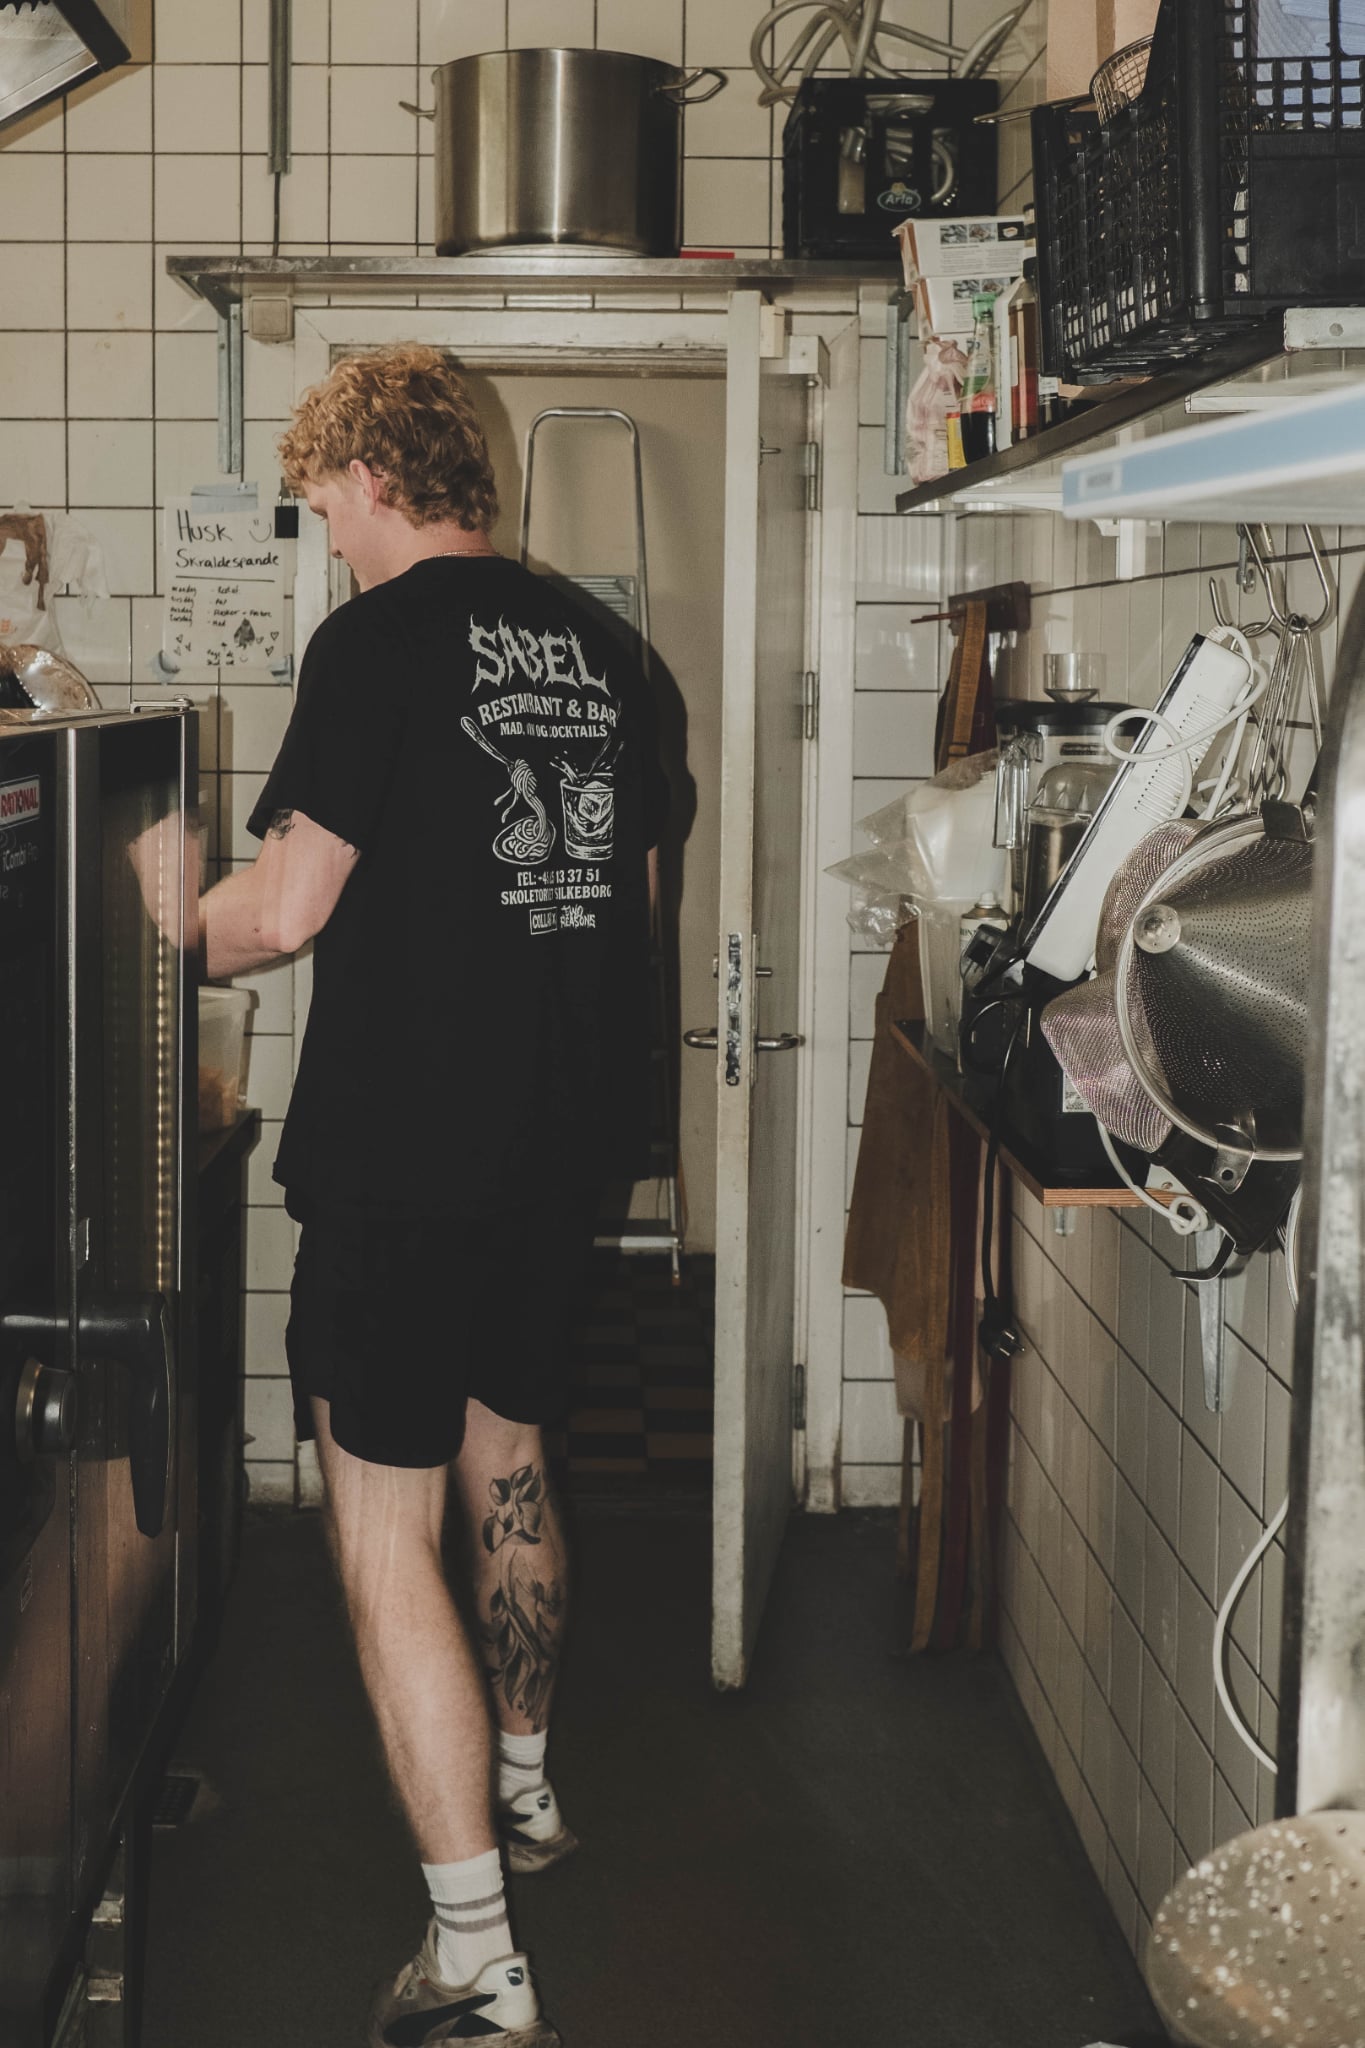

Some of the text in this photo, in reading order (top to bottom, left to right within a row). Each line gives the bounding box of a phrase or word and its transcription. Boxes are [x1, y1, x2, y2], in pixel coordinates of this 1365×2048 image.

[885, 193, 913, 205] Arla
[177, 509, 232, 543] Husk
[176, 548, 279, 568] Skraldespande
[468, 613, 611, 696] SABEL
[566, 699, 582, 718] &
[587, 700, 616, 727] BAR
[1, 787, 39, 817] RATIONAL
[567, 868, 582, 883] 37
[585, 868, 600, 882] 51
